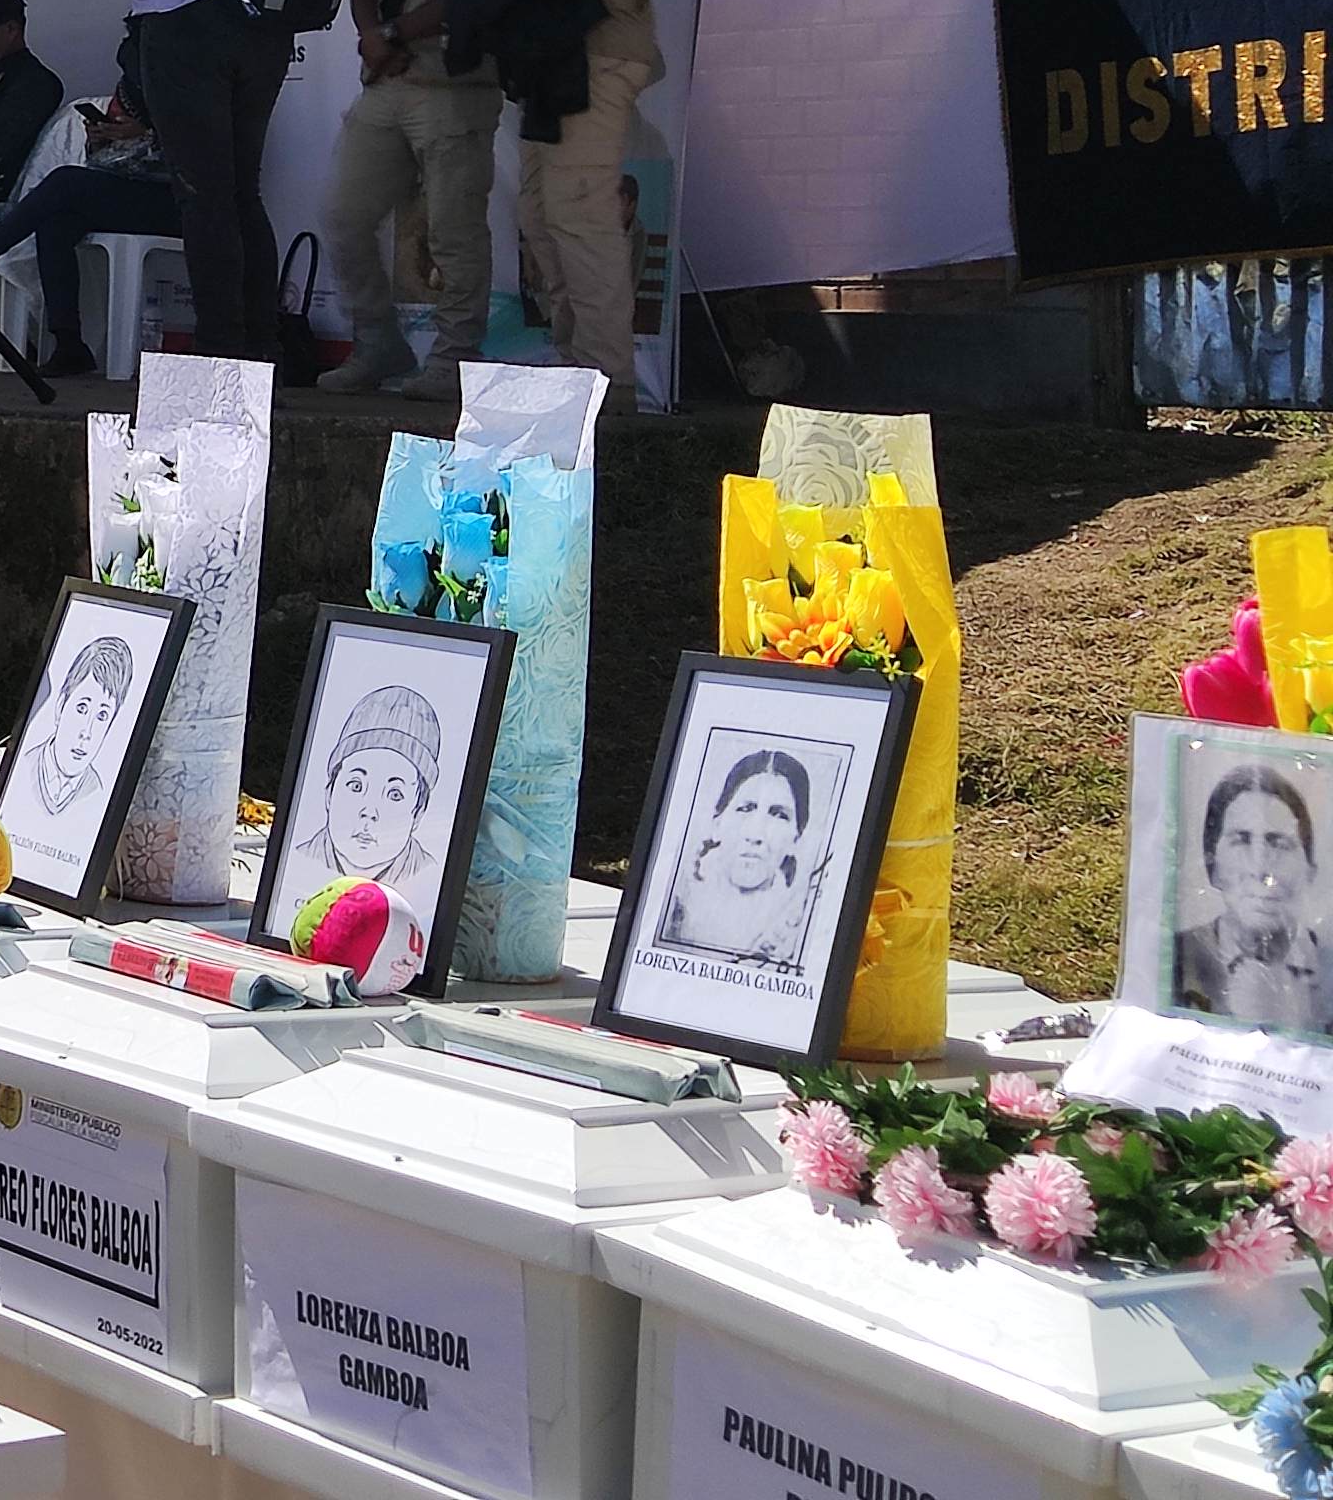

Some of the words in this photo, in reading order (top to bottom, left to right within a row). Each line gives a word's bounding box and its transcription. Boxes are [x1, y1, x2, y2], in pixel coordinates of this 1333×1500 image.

[634, 949, 696, 977] LORENZA
[698, 962, 751, 988] BALBOA
[754, 973, 814, 1001] GAMBOA
[1169, 1044, 1219, 1068] PAULINA
[1265, 1070, 1322, 1093] PALACIOS
[30, 1098, 81, 1124] MINISTERIO
[32, 1173, 87, 1251] FLORES
[91, 1195, 153, 1276] BALBOA
[97, 1317, 164, 1356] 20-05-2022
[296, 1290, 383, 1346] LORENZA
[386, 1315, 470, 1372] BALBOA
[339, 1353, 429, 1412] GAMBOA
[723, 1405, 832, 1488] PAULINA
